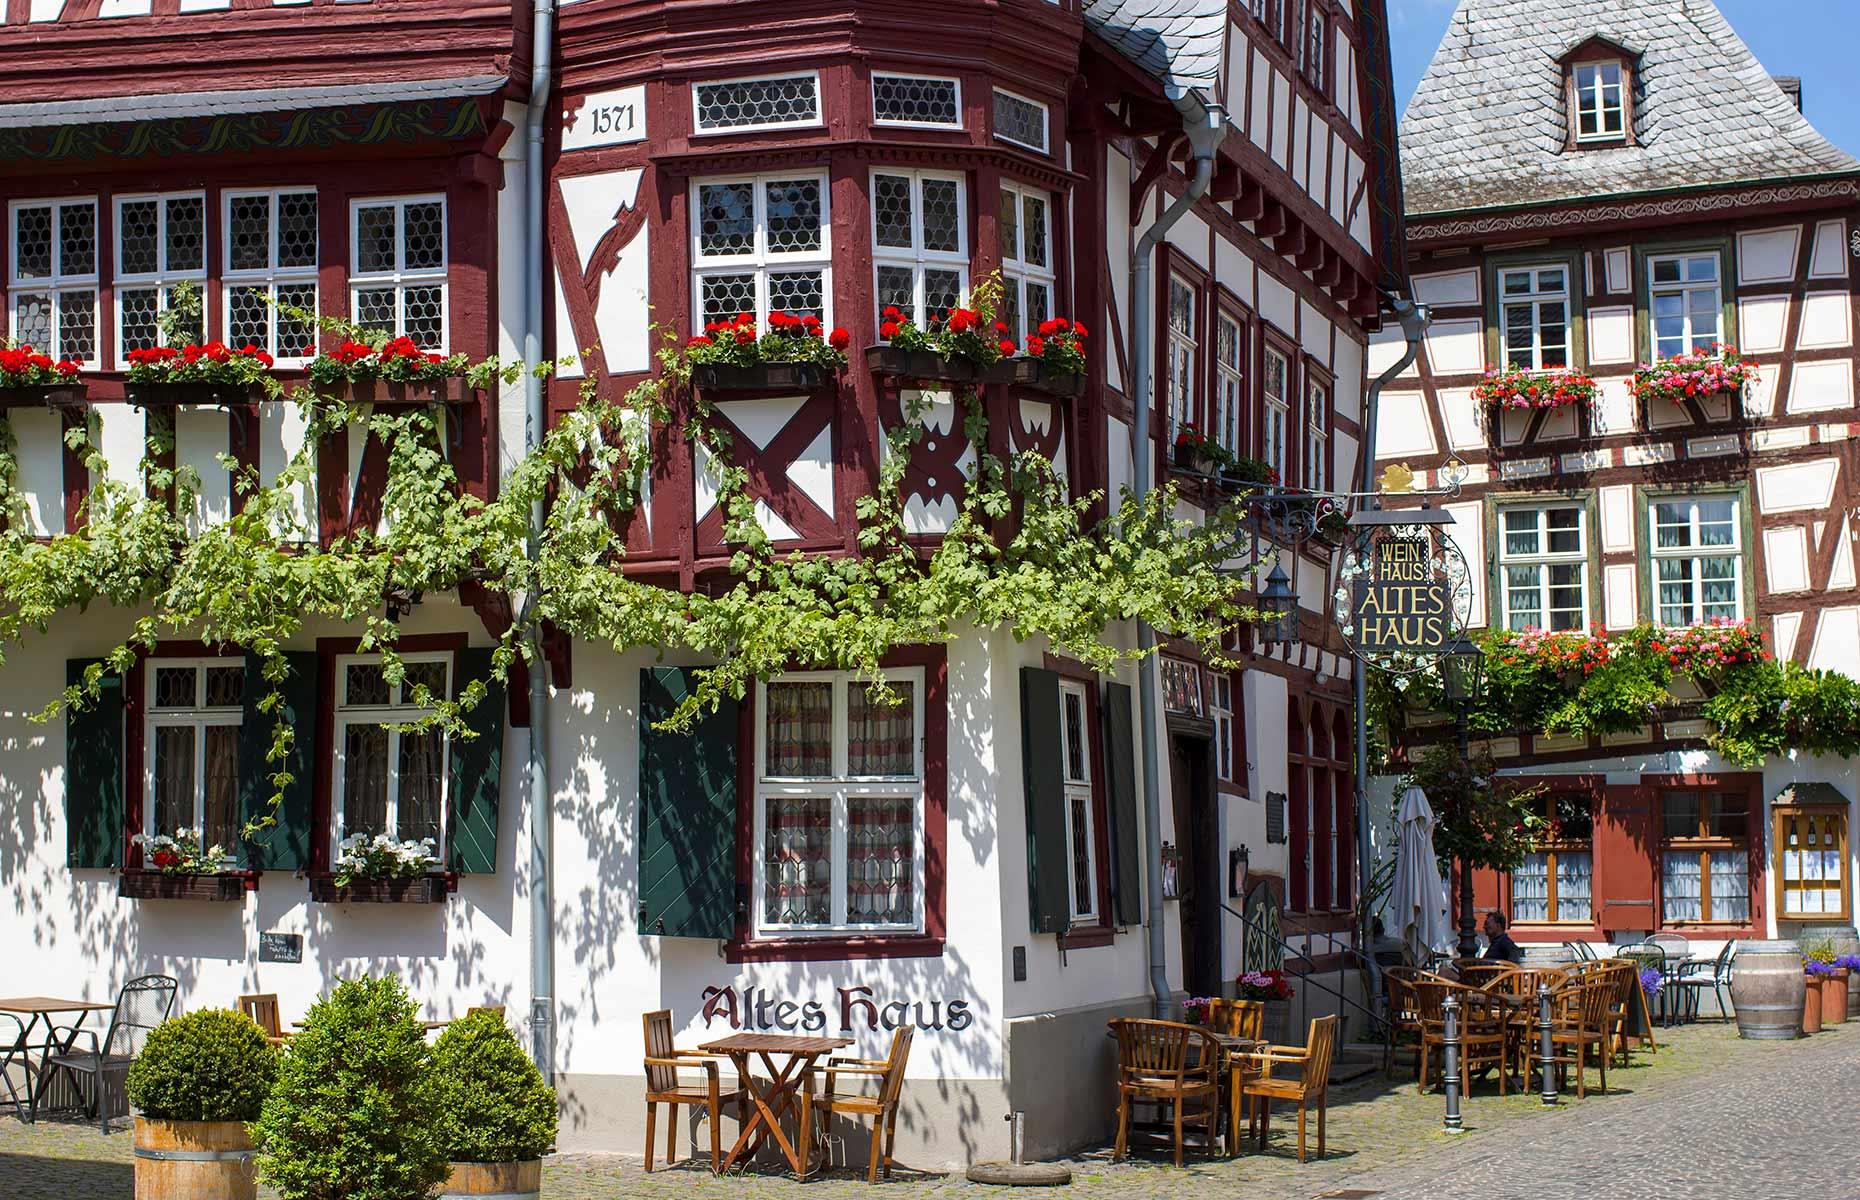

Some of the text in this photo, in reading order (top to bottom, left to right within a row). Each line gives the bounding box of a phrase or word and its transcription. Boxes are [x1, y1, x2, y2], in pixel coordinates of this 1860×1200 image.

[591, 104, 634, 135] 1571
[1381, 543, 1420, 562] WEIN
[1380, 562, 1424, 580] HAUS
[1358, 585, 1444, 614] ALTES
[1360, 616, 1444, 646] HAUS
[701, 985, 973, 1032] Altes Haus
